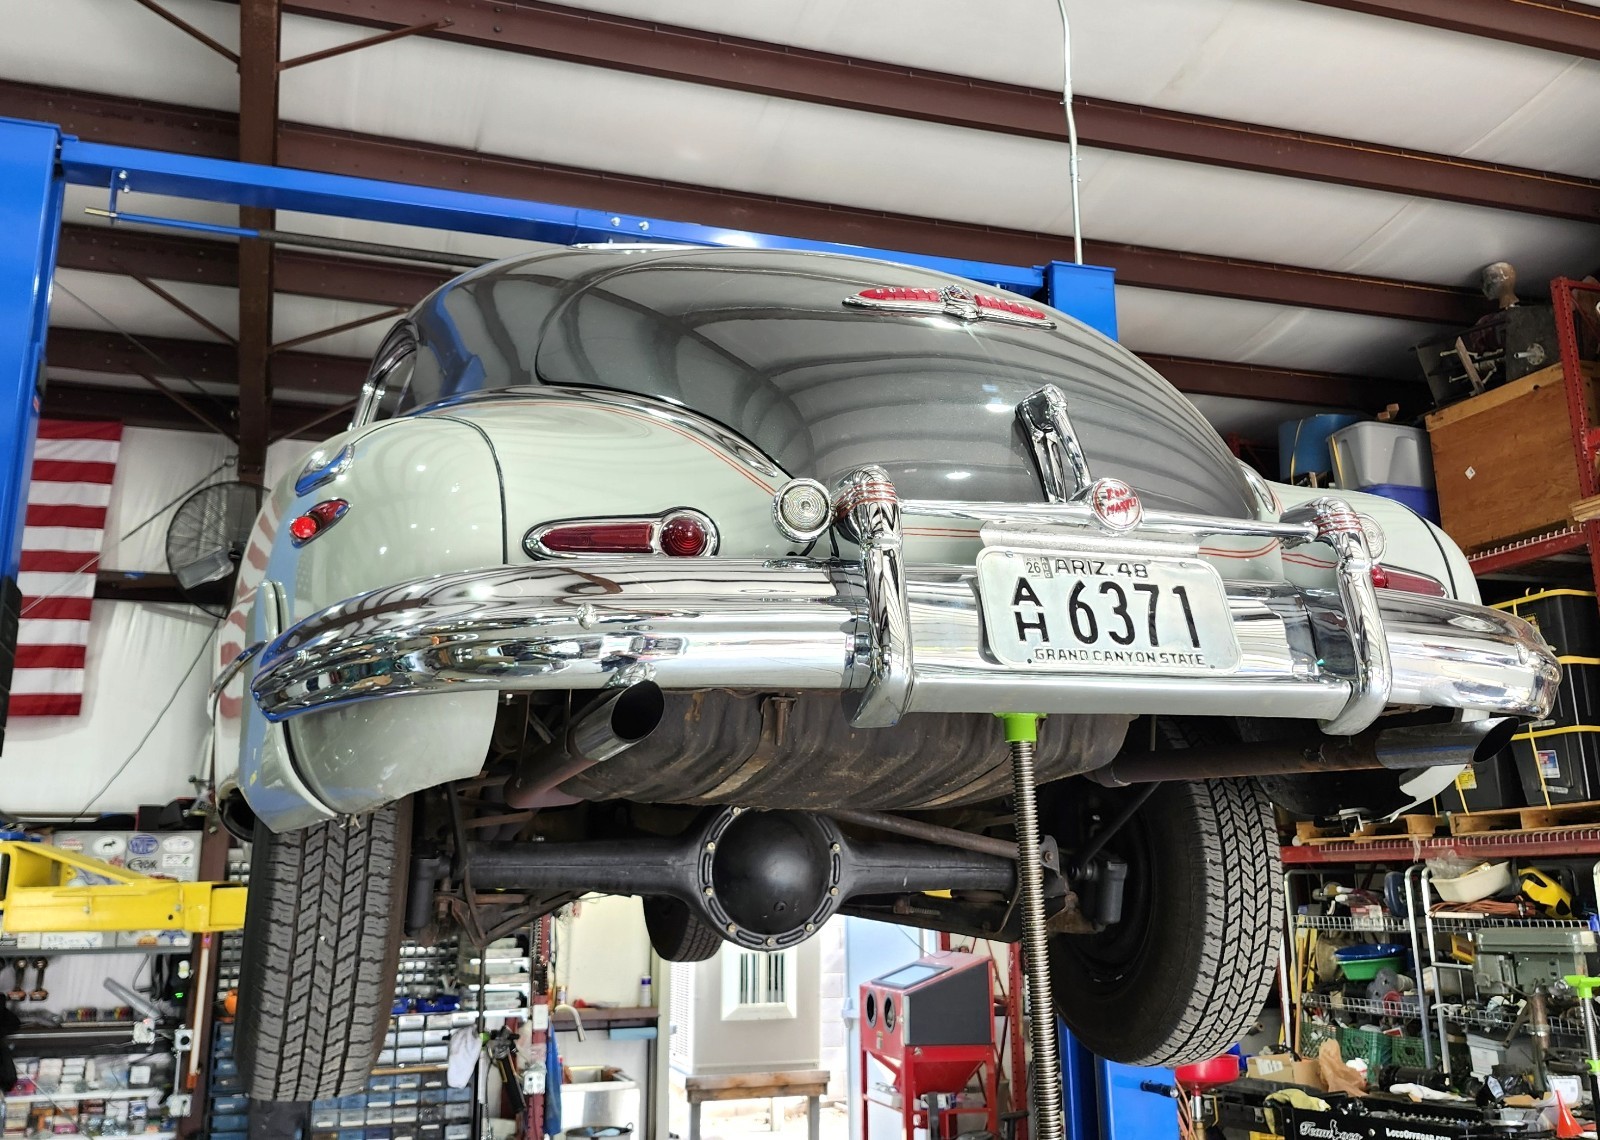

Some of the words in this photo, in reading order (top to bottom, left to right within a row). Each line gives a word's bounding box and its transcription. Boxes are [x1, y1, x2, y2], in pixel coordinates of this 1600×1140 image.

[1026, 561, 1041, 574] 26
[1118, 562, 1149, 578] 48
[1068, 580, 1201, 648] 6371
[1034, 648, 1088, 661] GRAND
[1093, 650, 1156, 663] CANYON
[1159, 653, 1207, 666] STATE
